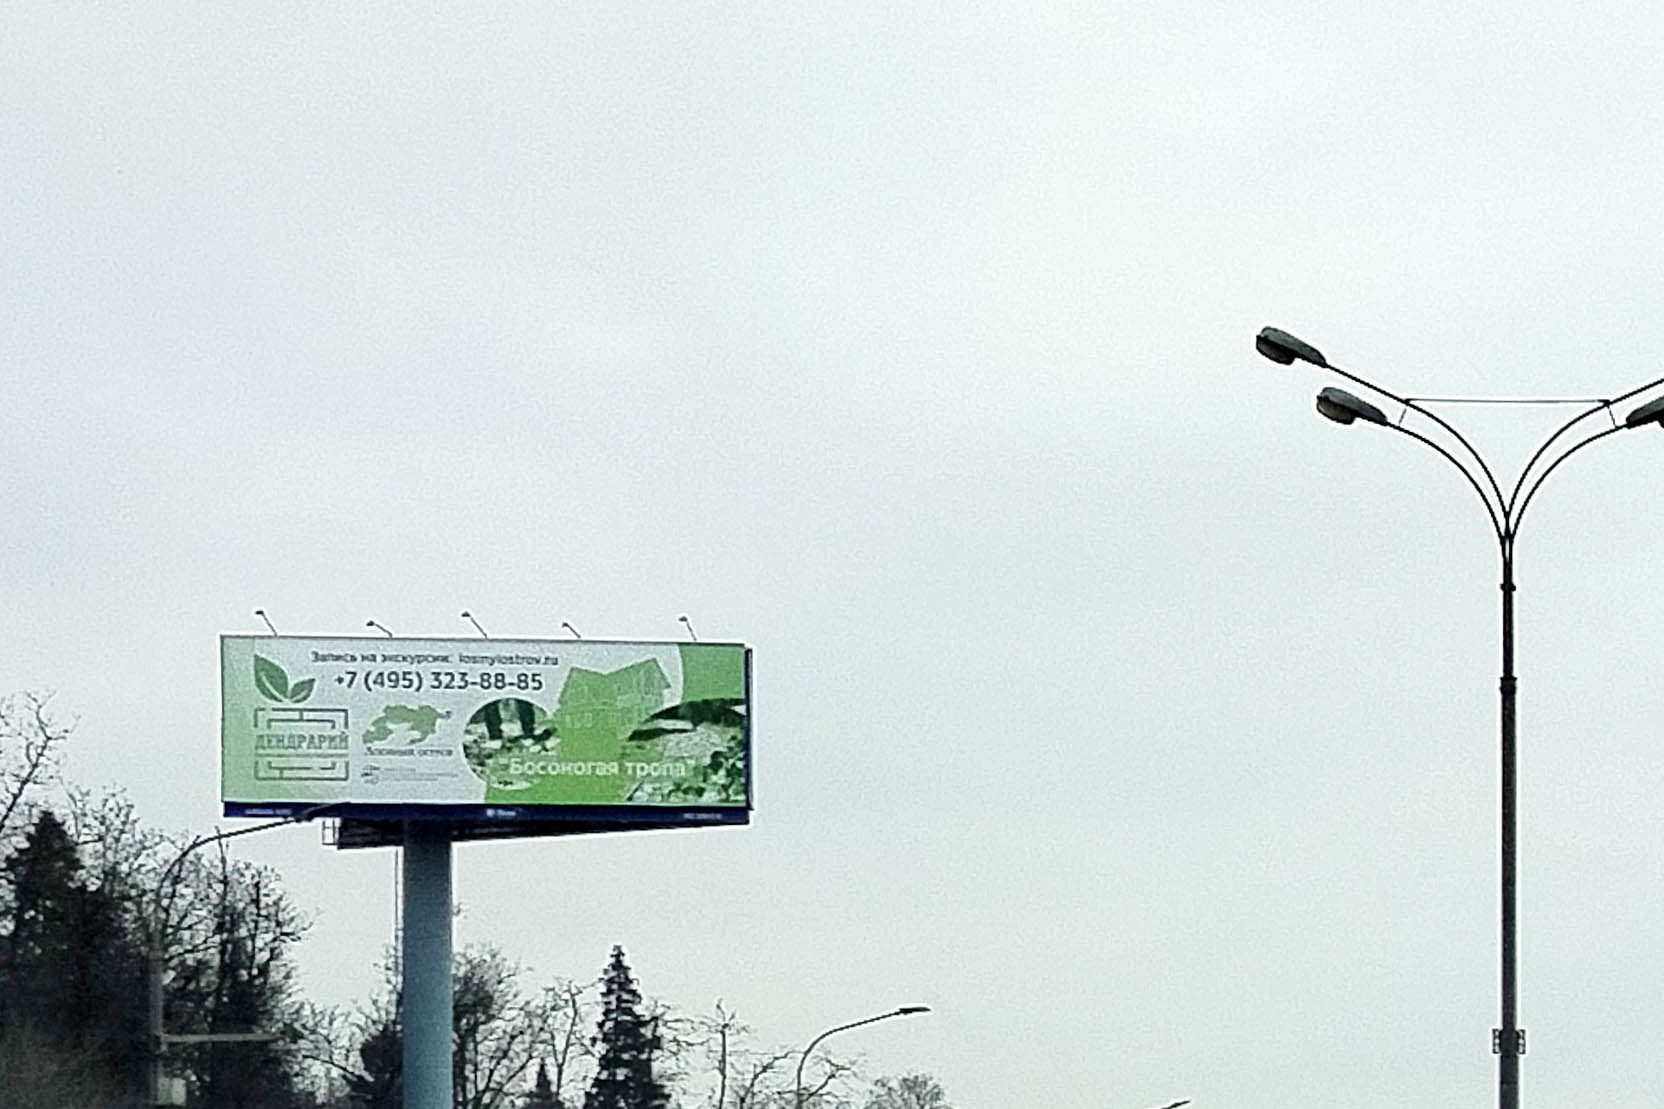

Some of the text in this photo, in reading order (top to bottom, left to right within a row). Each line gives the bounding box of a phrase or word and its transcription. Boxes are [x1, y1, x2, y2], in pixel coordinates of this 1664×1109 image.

[334, 670, 544, 692] +7 (495) 323-88-85
[254, 731, 349, 751] ДЕНДРАРИЙ
